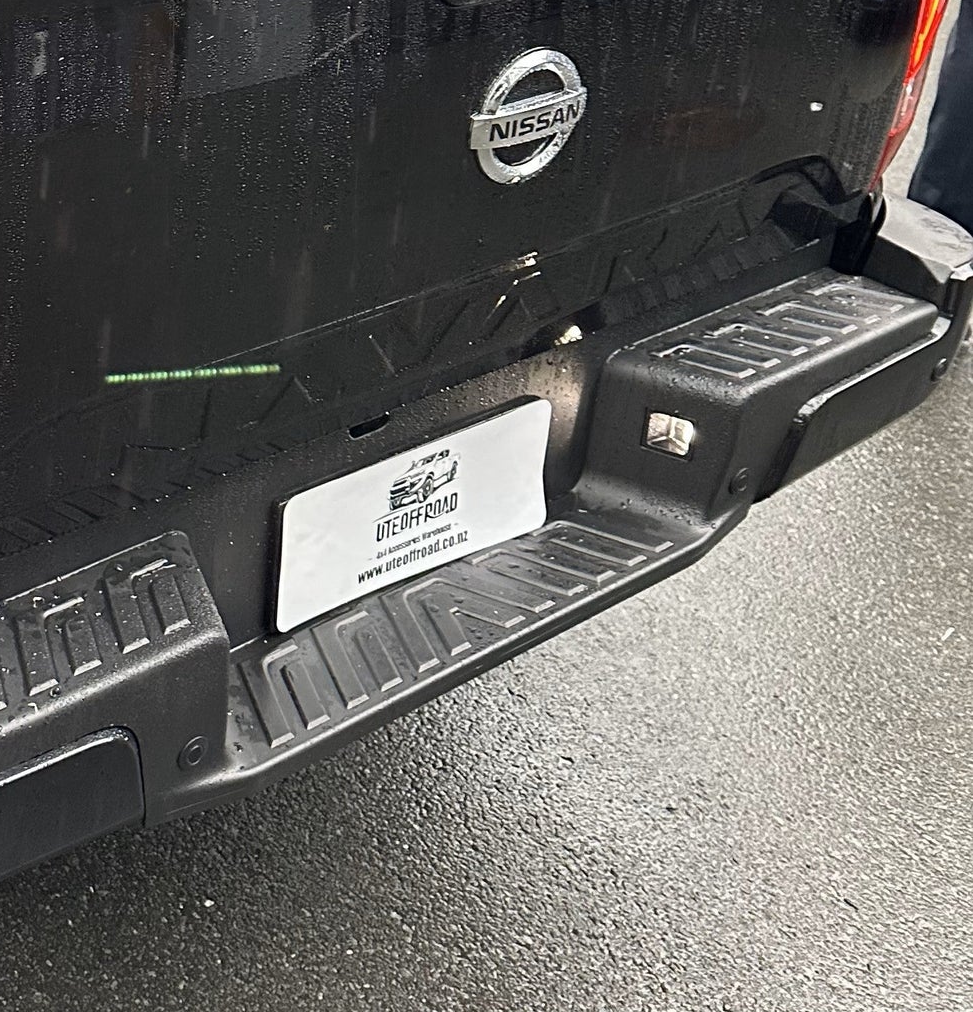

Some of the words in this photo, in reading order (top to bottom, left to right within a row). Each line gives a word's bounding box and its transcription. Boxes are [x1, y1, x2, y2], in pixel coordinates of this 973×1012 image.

[489, 100, 580, 142] NISSAN
[376, 492, 458, 542] UTEOFFROAD
[357, 530, 469, 584] www.uteoffroad.co.nz
